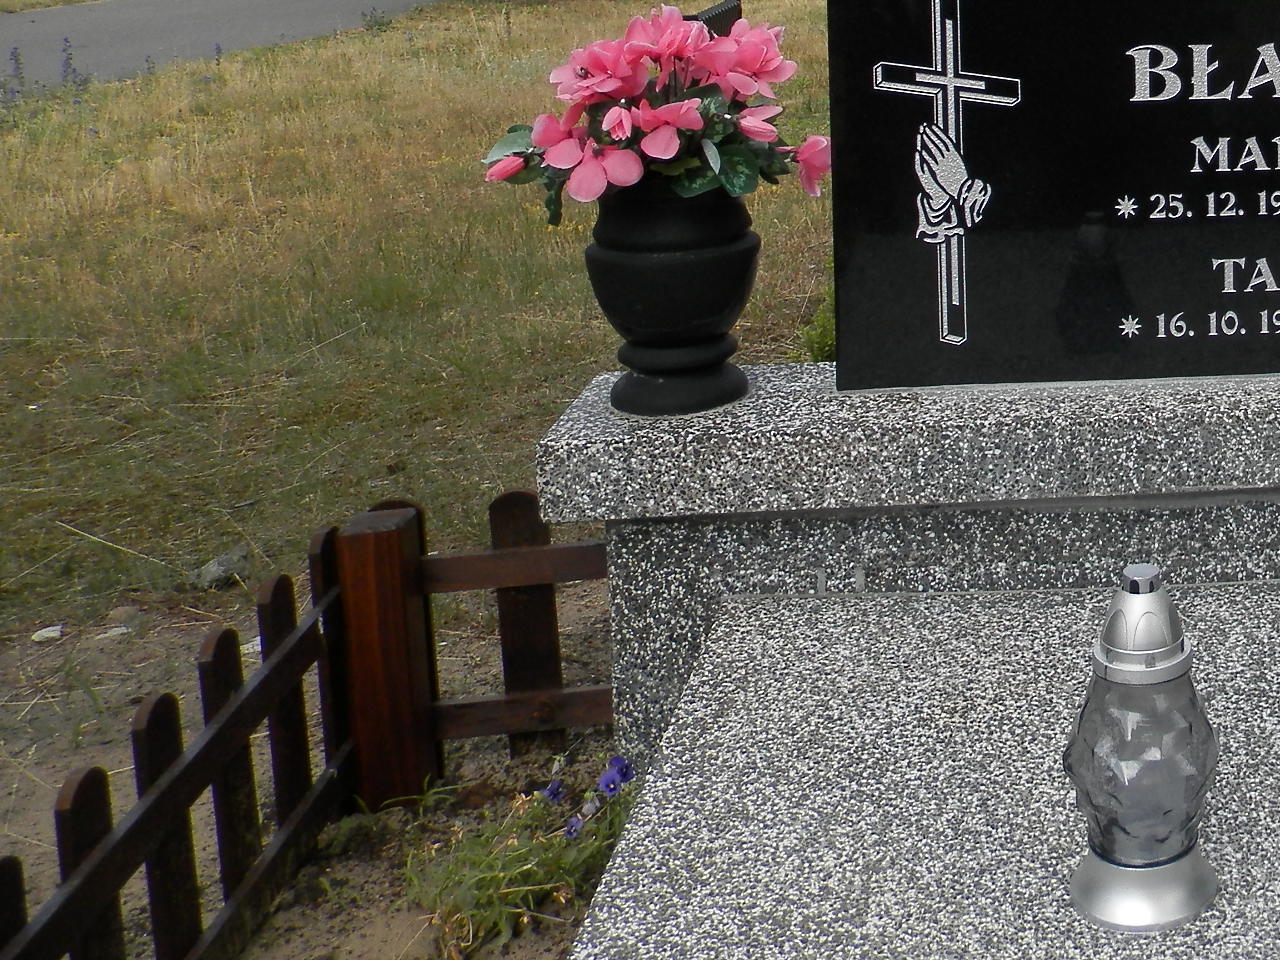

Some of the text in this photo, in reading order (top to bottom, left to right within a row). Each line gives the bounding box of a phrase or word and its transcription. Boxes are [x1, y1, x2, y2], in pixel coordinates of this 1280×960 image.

[1149, 193, 1193, 219] 25.
[1205, 191, 1245, 217] 12.
[1155, 311, 1195, 338] 16.
[1207, 310, 1247, 336] 10.
